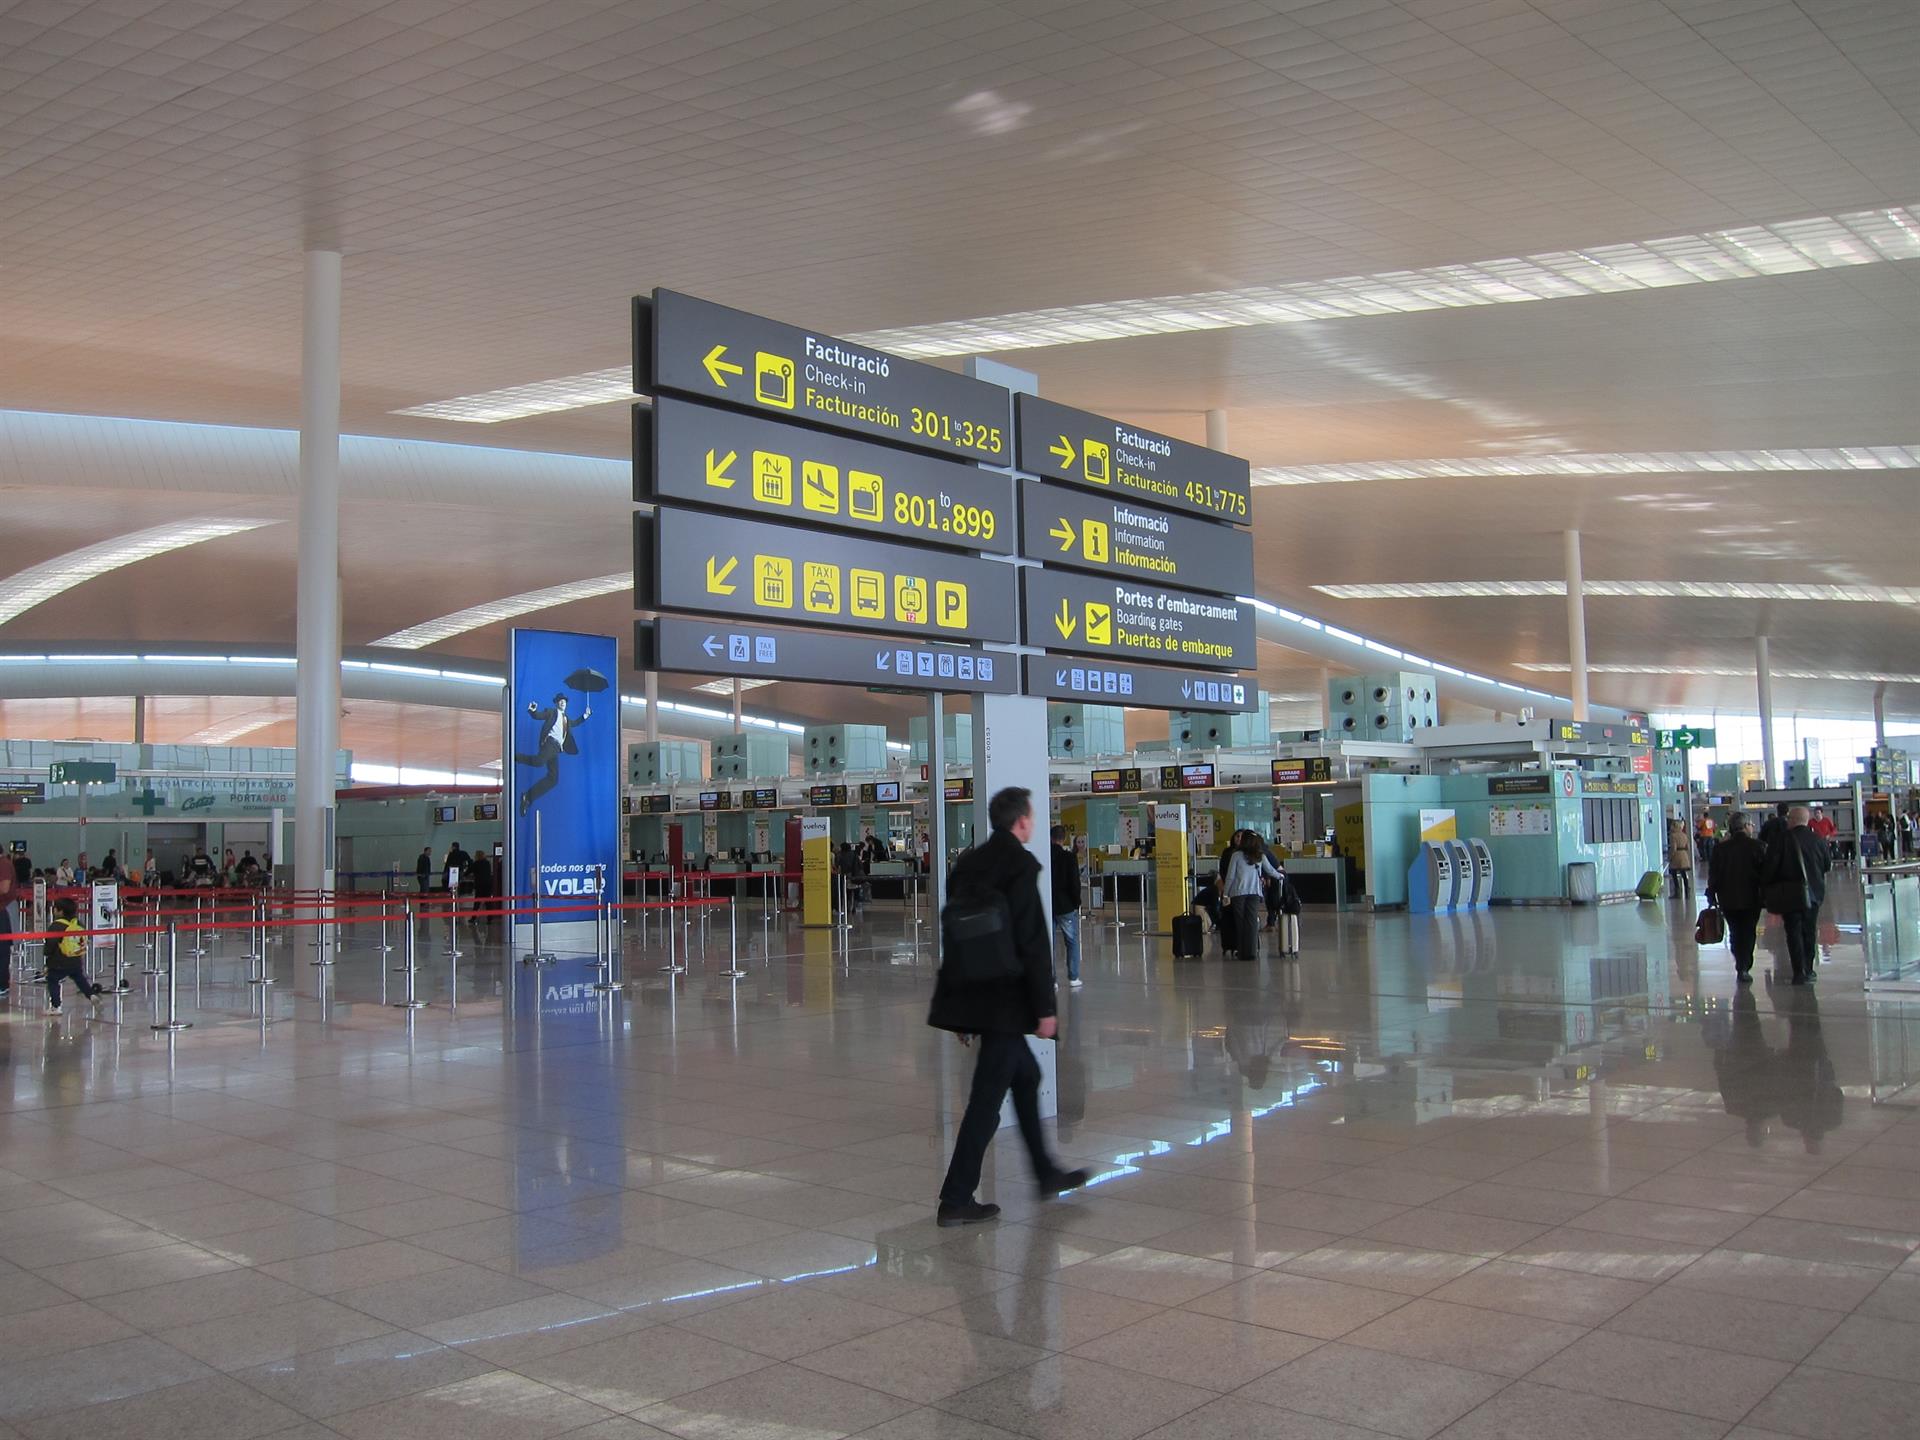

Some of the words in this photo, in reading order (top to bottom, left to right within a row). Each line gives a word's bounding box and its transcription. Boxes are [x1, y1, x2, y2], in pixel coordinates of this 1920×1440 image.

[805, 336, 890, 378] Facturació
[805, 363, 866, 395] Check-in
[806, 387, 900, 429] Facturación
[910, 407, 951, 442] 301
[954, 419, 962, 432] to
[962, 421, 1002, 454] 325
[1115, 426, 1171, 457] Facturació
[1115, 448, 1156, 472] Check-in
[940, 491, 951, 508] to
[1117, 467, 1179, 498] Facturación
[1185, 481, 1213, 507] 451
[1219, 489, 1247, 516] 775
[894, 491, 938, 529] 801
[952, 504, 995, 540] 899
[1113, 505, 1169, 534] Informació
[942, 517, 950, 532] a
[1114, 527, 1165, 551] Information
[811, 565, 833, 578] TAXI
[1115, 546, 1177, 575] Información
[906, 612, 916, 622] T2
[945, 590, 960, 621] P
[1116, 586, 1154, 609] Portes
[1157, 594, 1238, 622] d'embarcament
[1116, 608, 1157, 631] Boarding
[1159, 617, 1183, 632] gates
[1117, 628, 1162, 650] Puertas
[1165, 634, 1179, 651] de
[1182, 638, 1233, 660] embarque
[1124, 781, 1140, 790] 403
[1163, 779, 1178, 788] 402
[803, 822, 826, 831] vueling
[1155, 811, 1180, 821] vueling
[541, 863, 567, 873] todos
[569, 864, 584, 872] nos
